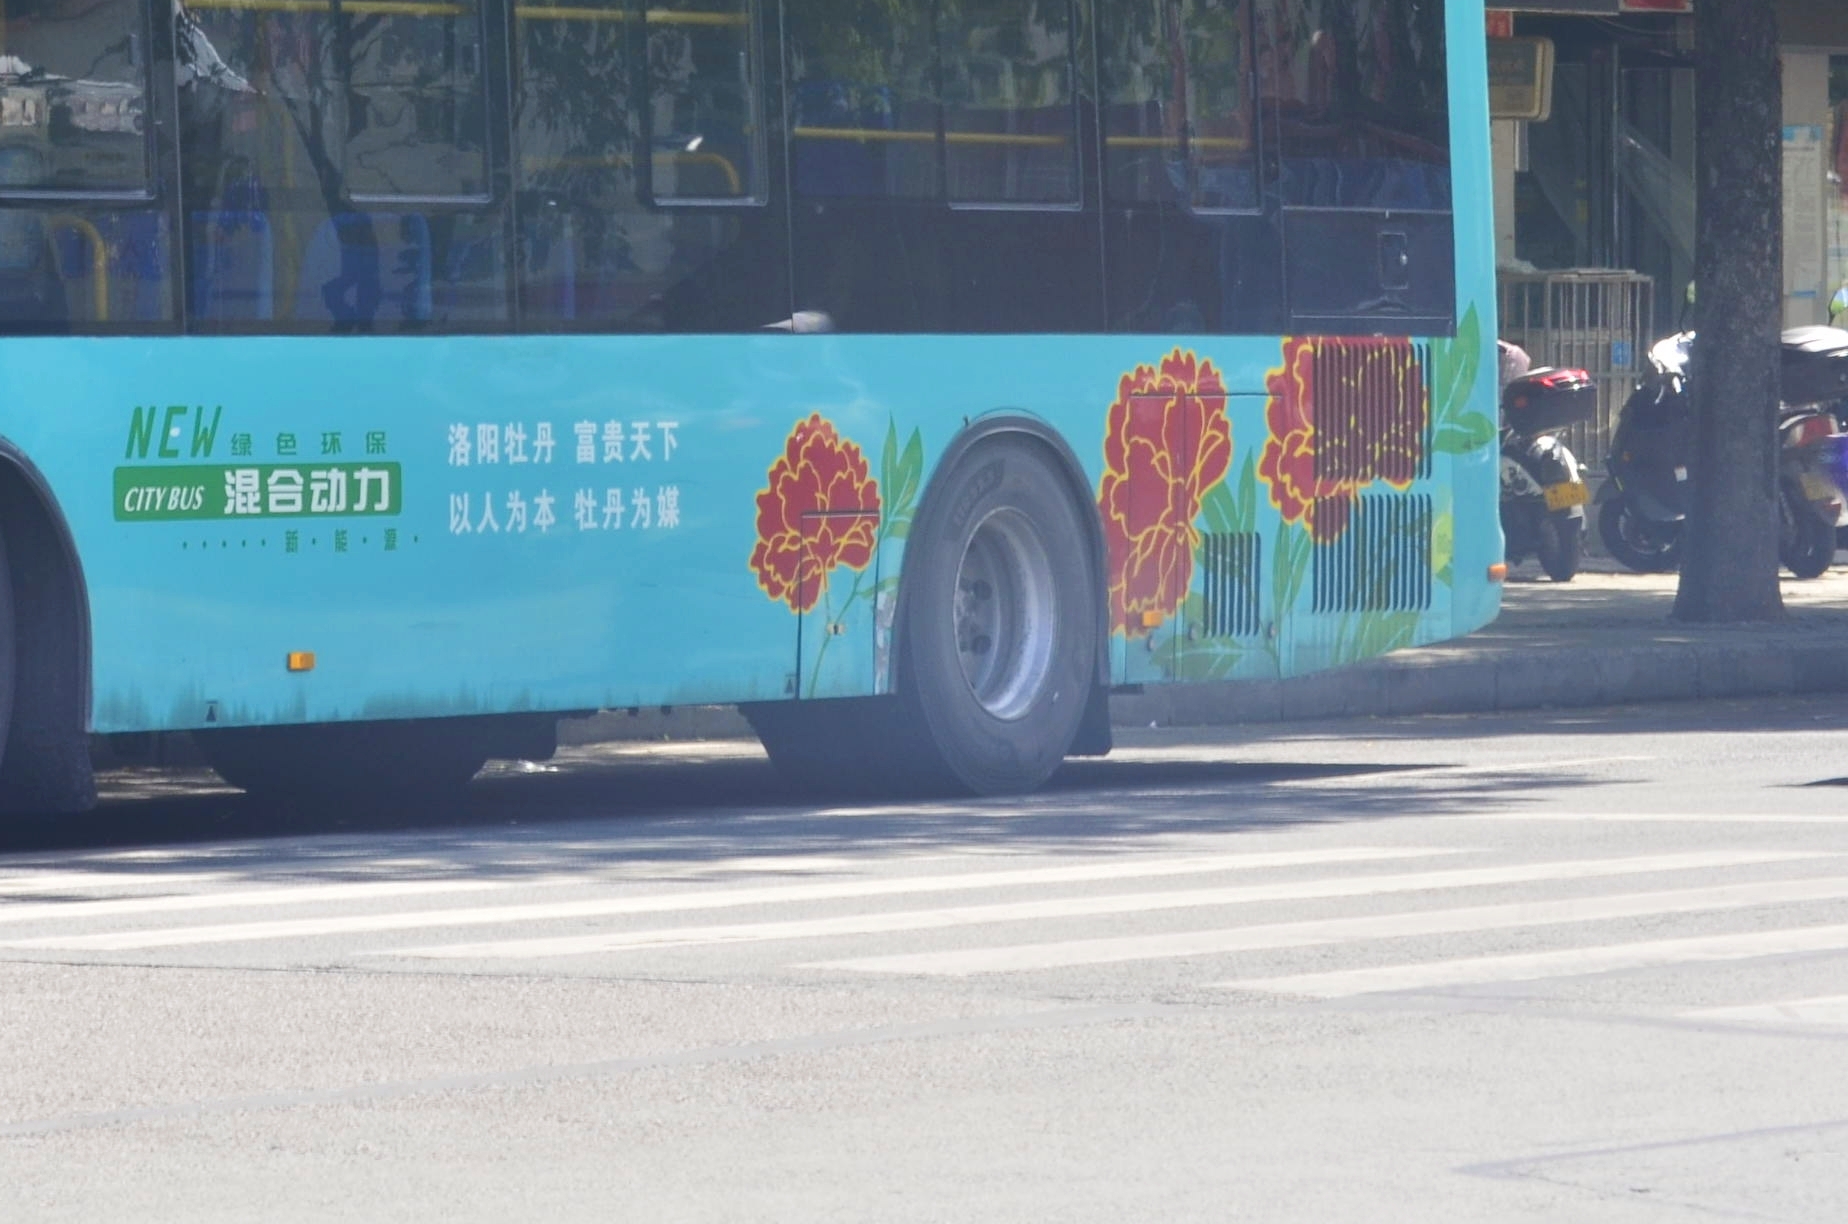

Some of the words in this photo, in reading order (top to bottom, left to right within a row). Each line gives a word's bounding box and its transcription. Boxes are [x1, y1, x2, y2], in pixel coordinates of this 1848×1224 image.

[125, 406, 221, 459] NEW
[230, 431, 387, 456] 绿色环保
[448, 422, 556, 466] 洛阳牡丹
[573, 419, 679, 464] 富贵天下
[124, 487, 166, 512] CITY
[167, 484, 205, 511] BUS
[223, 467, 391, 515] 混合动力
[449, 488, 556, 535] 以人为本
[573, 485, 681, 532] 牡丹为媒
